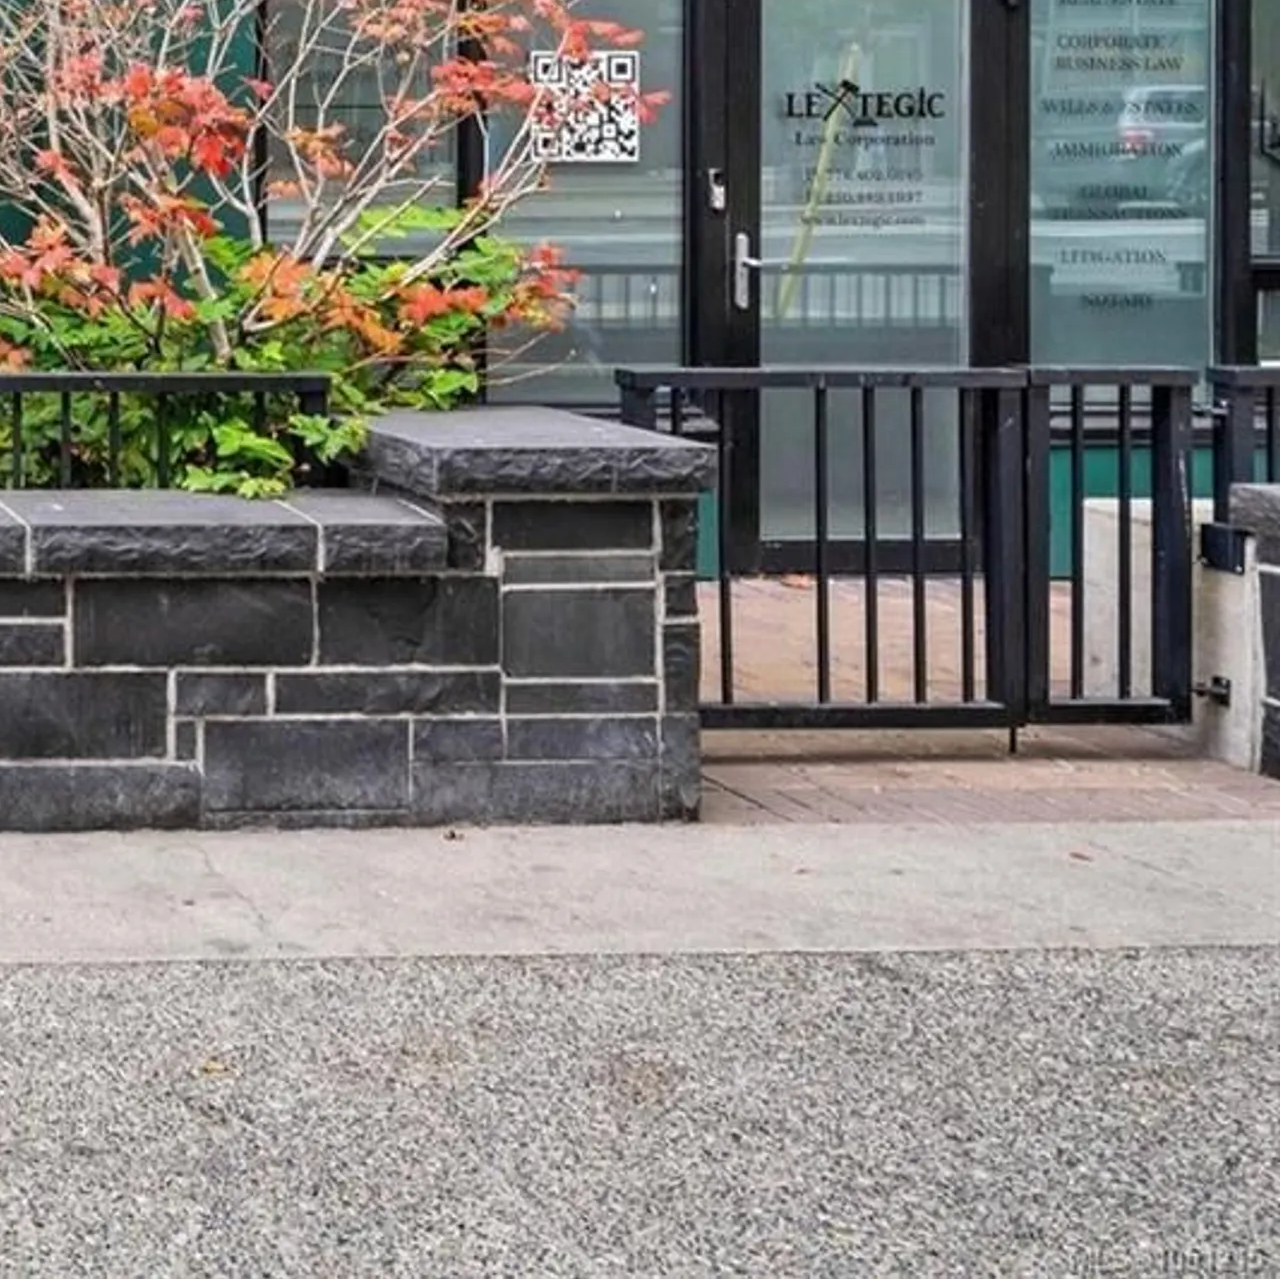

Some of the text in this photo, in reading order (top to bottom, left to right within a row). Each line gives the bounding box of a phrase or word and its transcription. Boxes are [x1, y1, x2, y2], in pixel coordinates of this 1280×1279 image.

[1056, 34, 1163, 49] CORPORATE
[1054, 56, 1184, 71] BUSINESS LAW
[1041, 98, 1098, 114] WILLS
[835, 132, 935, 151] Corporation
[1052, 142, 1183, 157] IMMIGRATION
[1060, 249, 1166, 264] LITIGATION
